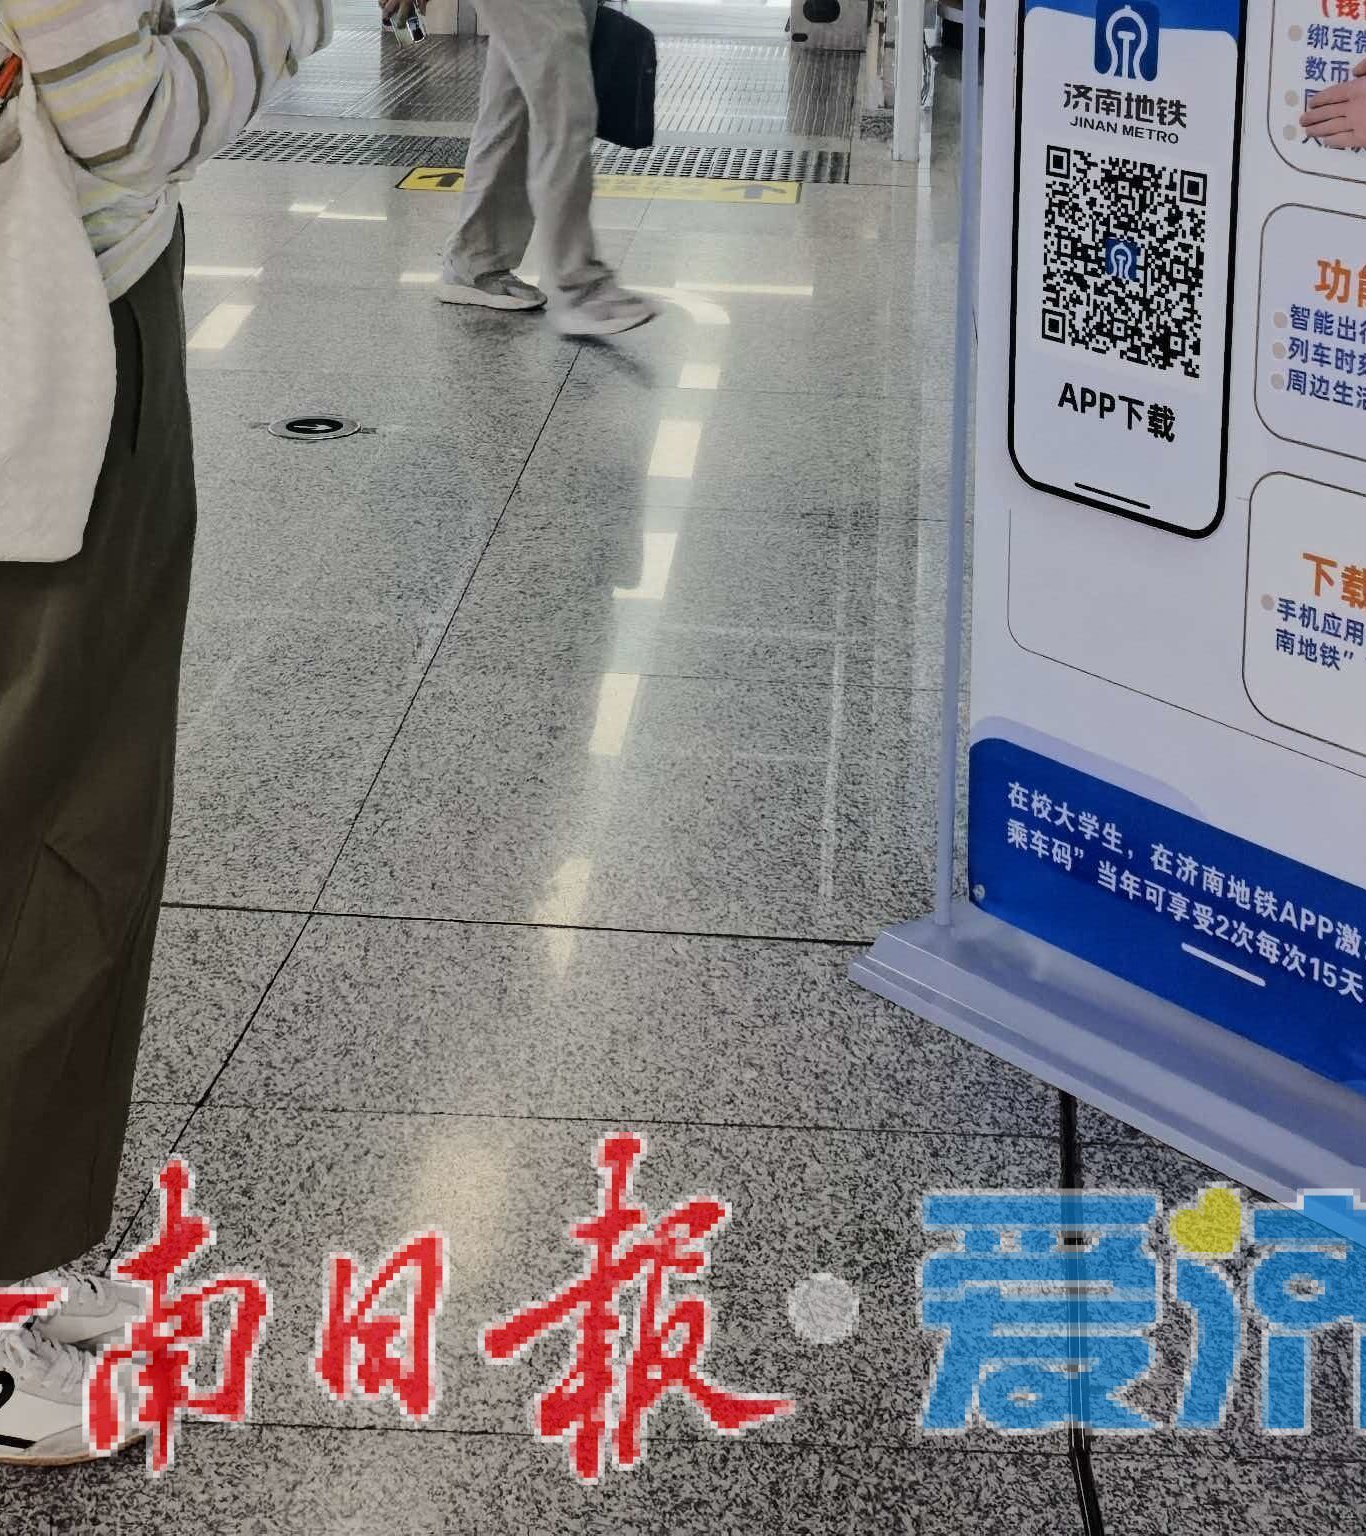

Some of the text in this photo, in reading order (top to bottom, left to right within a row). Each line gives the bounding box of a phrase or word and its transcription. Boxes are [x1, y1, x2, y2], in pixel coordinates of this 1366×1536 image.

[1063, 83, 1187, 130] 济南地铁
[1070, 115, 1179, 145] JINAN METRO
[1057, 382, 1177, 442] APP下载
